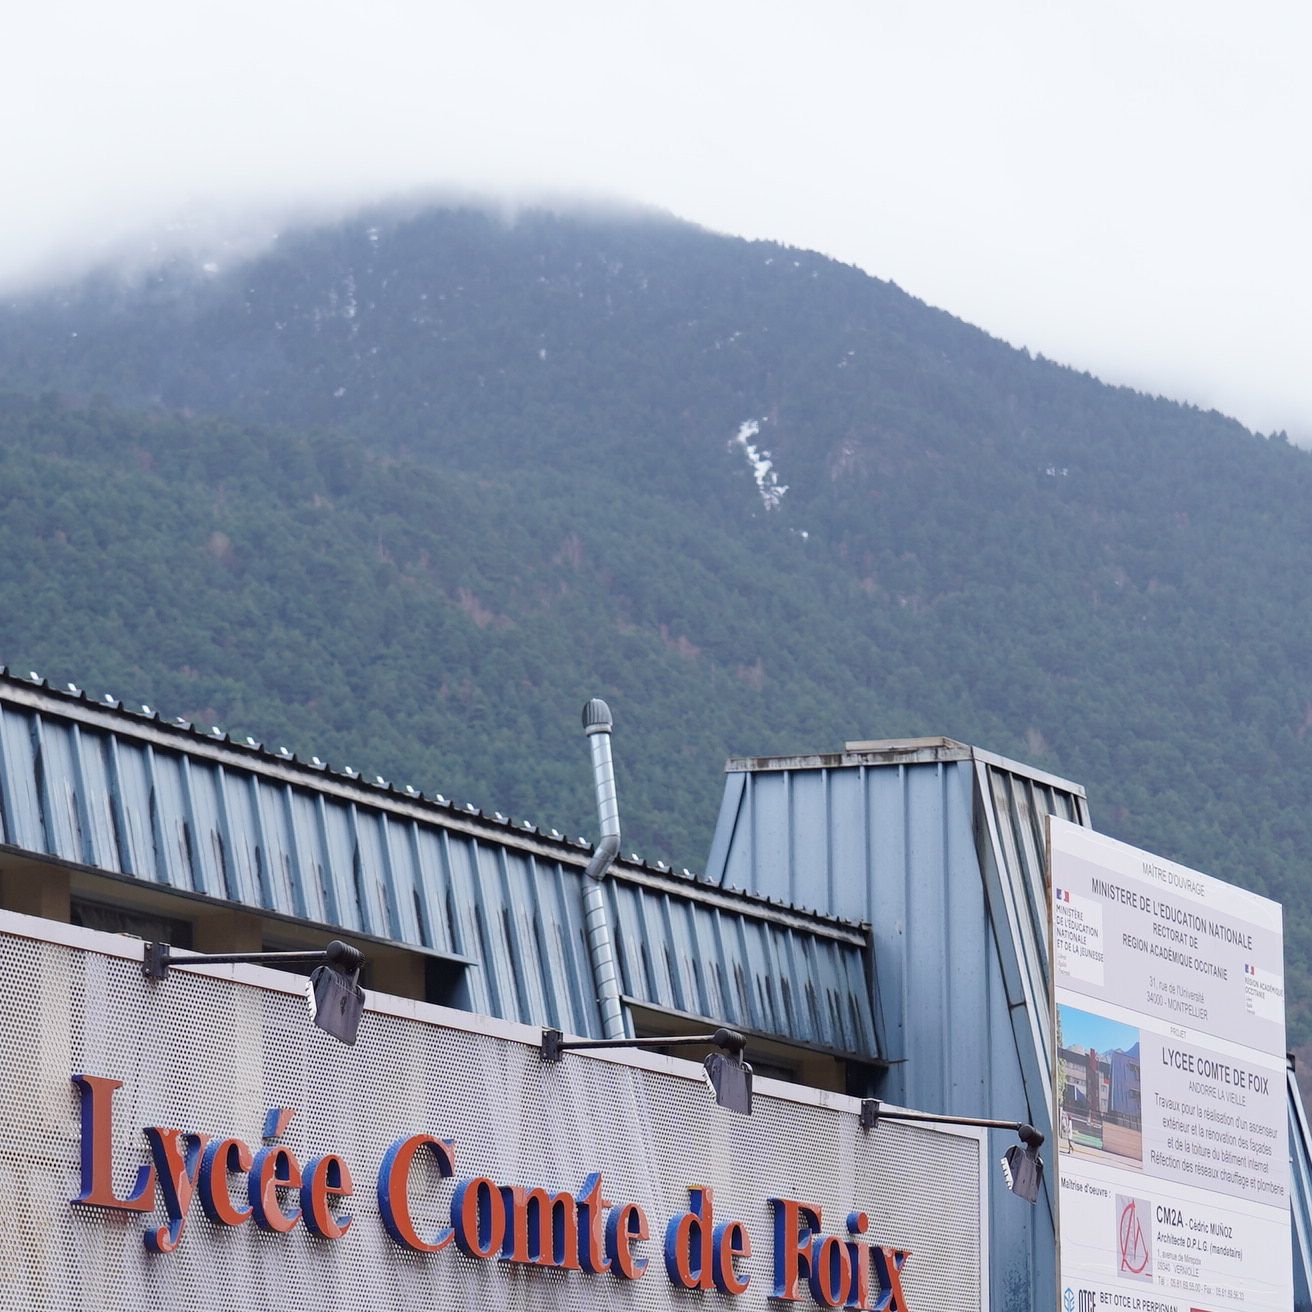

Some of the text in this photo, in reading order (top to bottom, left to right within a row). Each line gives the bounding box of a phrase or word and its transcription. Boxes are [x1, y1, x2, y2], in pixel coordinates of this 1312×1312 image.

[1168, 871, 1204, 897] D'OUVRAGE
[1056, 915, 1063, 926] DE
[1091, 877, 1252, 950] MINISTERE DE L'EDUCATION NATIONALE
[1056, 926, 1086, 945] NATIONALE
[1152, 922, 1197, 949] RECTORAT DE
[1056, 938, 1063, 949] ET
[1064, 941, 1071, 952] DE
[1072, 944, 1078, 955] LA
[1079, 945, 1103, 964] JEUNESSE
[1122, 933, 1227, 981] REGION ACADÉMIQUE OCCITANIE
[1158, 980, 1167, 991] rue
[1168, 982, 1175, 995] de
[1167, 997, 1207, 1021] MONTPELLIER
[1162, 1046, 1268, 1096] LYCEE COMTE DE FOIX
[1188, 1080, 1216, 1098] ANDORRE
[1217, 1088, 1224, 1101] LA
[1154, 1092, 1277, 1139] Travaux pour la réalisation d'un ascenseur
[1162, 1114, 1271, 1156] extérieur et la rénovation des façades
[1167, 1137, 1268, 1174] et de la toiture du bâtiment internat
[72, 1072, 355, 1255] Lycée
[378, 1132, 649, 1281] Comte
[663, 1184, 753, 1296] de
[1060, 1177, 1082, 1191] Maîtrise
[1150, 1150, 1283, 1196] Réfection des réseaux chauffage et plomberie
[1156, 1205, 1232, 1238] CM2A Cédric MUÑOZ
[1157, 1231, 1184, 1246] Architecte
[1209, 1242, 1242, 1260] (mandataire)
[1100, 1292, 1111, 1304] BET
[1113, 1294, 1130, 1308] OTCE
[1132, 1298, 1140, 1310] LR
